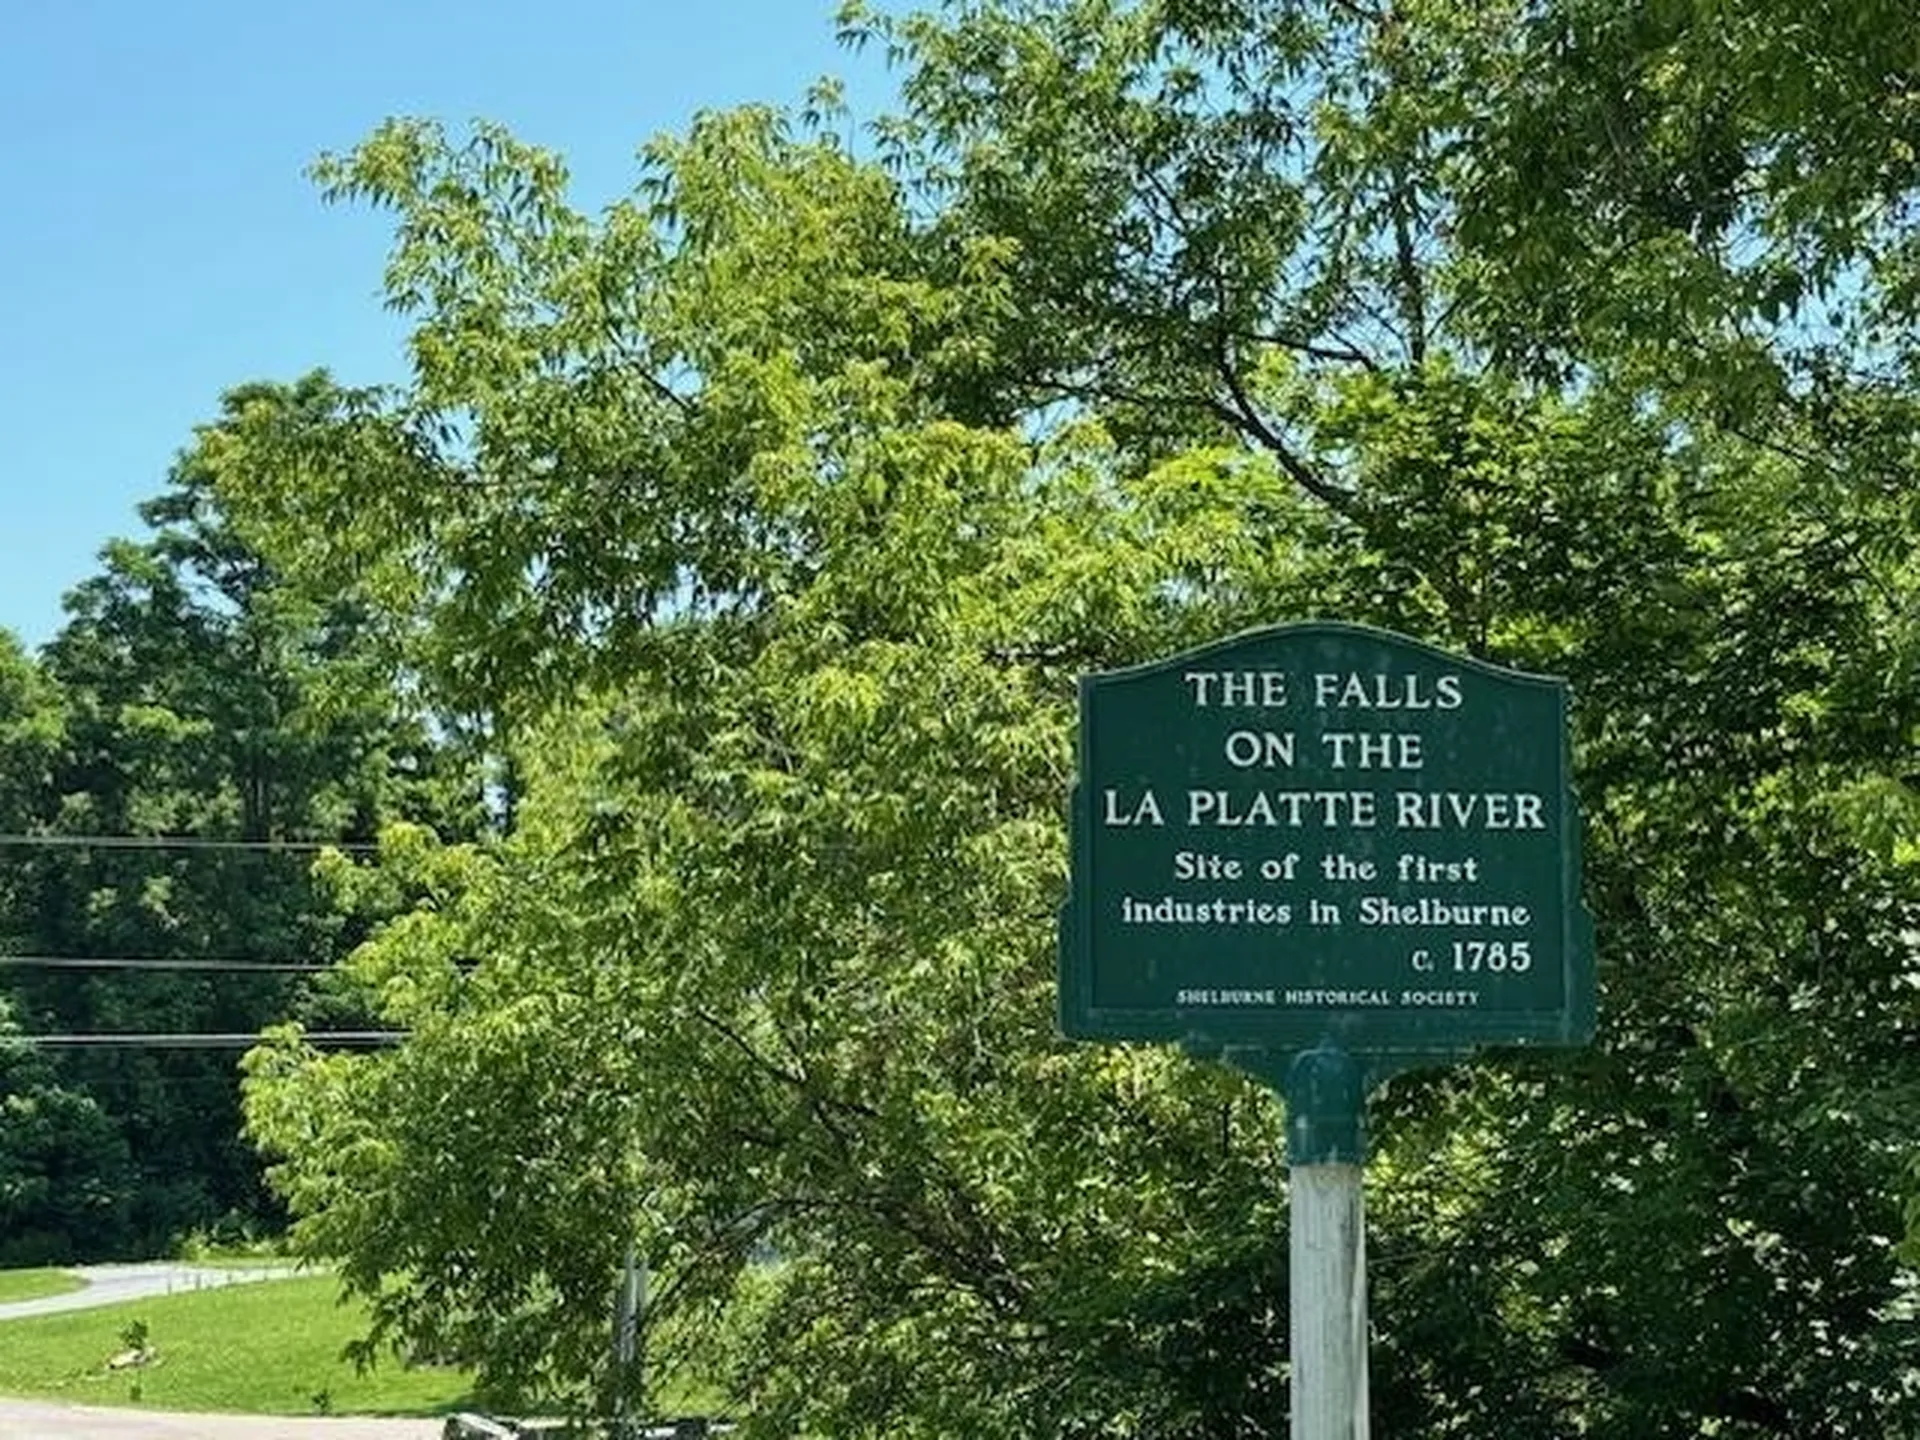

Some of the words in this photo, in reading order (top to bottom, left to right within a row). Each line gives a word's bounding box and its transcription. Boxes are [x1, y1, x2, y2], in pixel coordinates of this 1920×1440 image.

[1185, 672, 1287, 707] THE
[1315, 673, 1462, 709] FALLS
[1225, 731, 1294, 767] ON
[1322, 733, 1423, 769] THE
[1105, 789, 1164, 826] LA
[1188, 790, 1376, 827] PLATTE
[1396, 792, 1545, 829] RIVER
[1175, 852, 1243, 880] Site
[1260, 852, 1300, 880] of
[1320, 854, 1377, 881] the
[1397, 854, 1478, 882] first
[1122, 897, 1291, 924] industries
[1310, 899, 1340, 924] in
[1359, 898, 1531, 926] Shelburne
[1453, 941, 1531, 972] 1785
[1177, 990, 1275, 1004] SHELBURNE
[1285, 990, 1389, 1005] HISTORICAL
[1401, 991, 1480, 1006] SOCIETY
